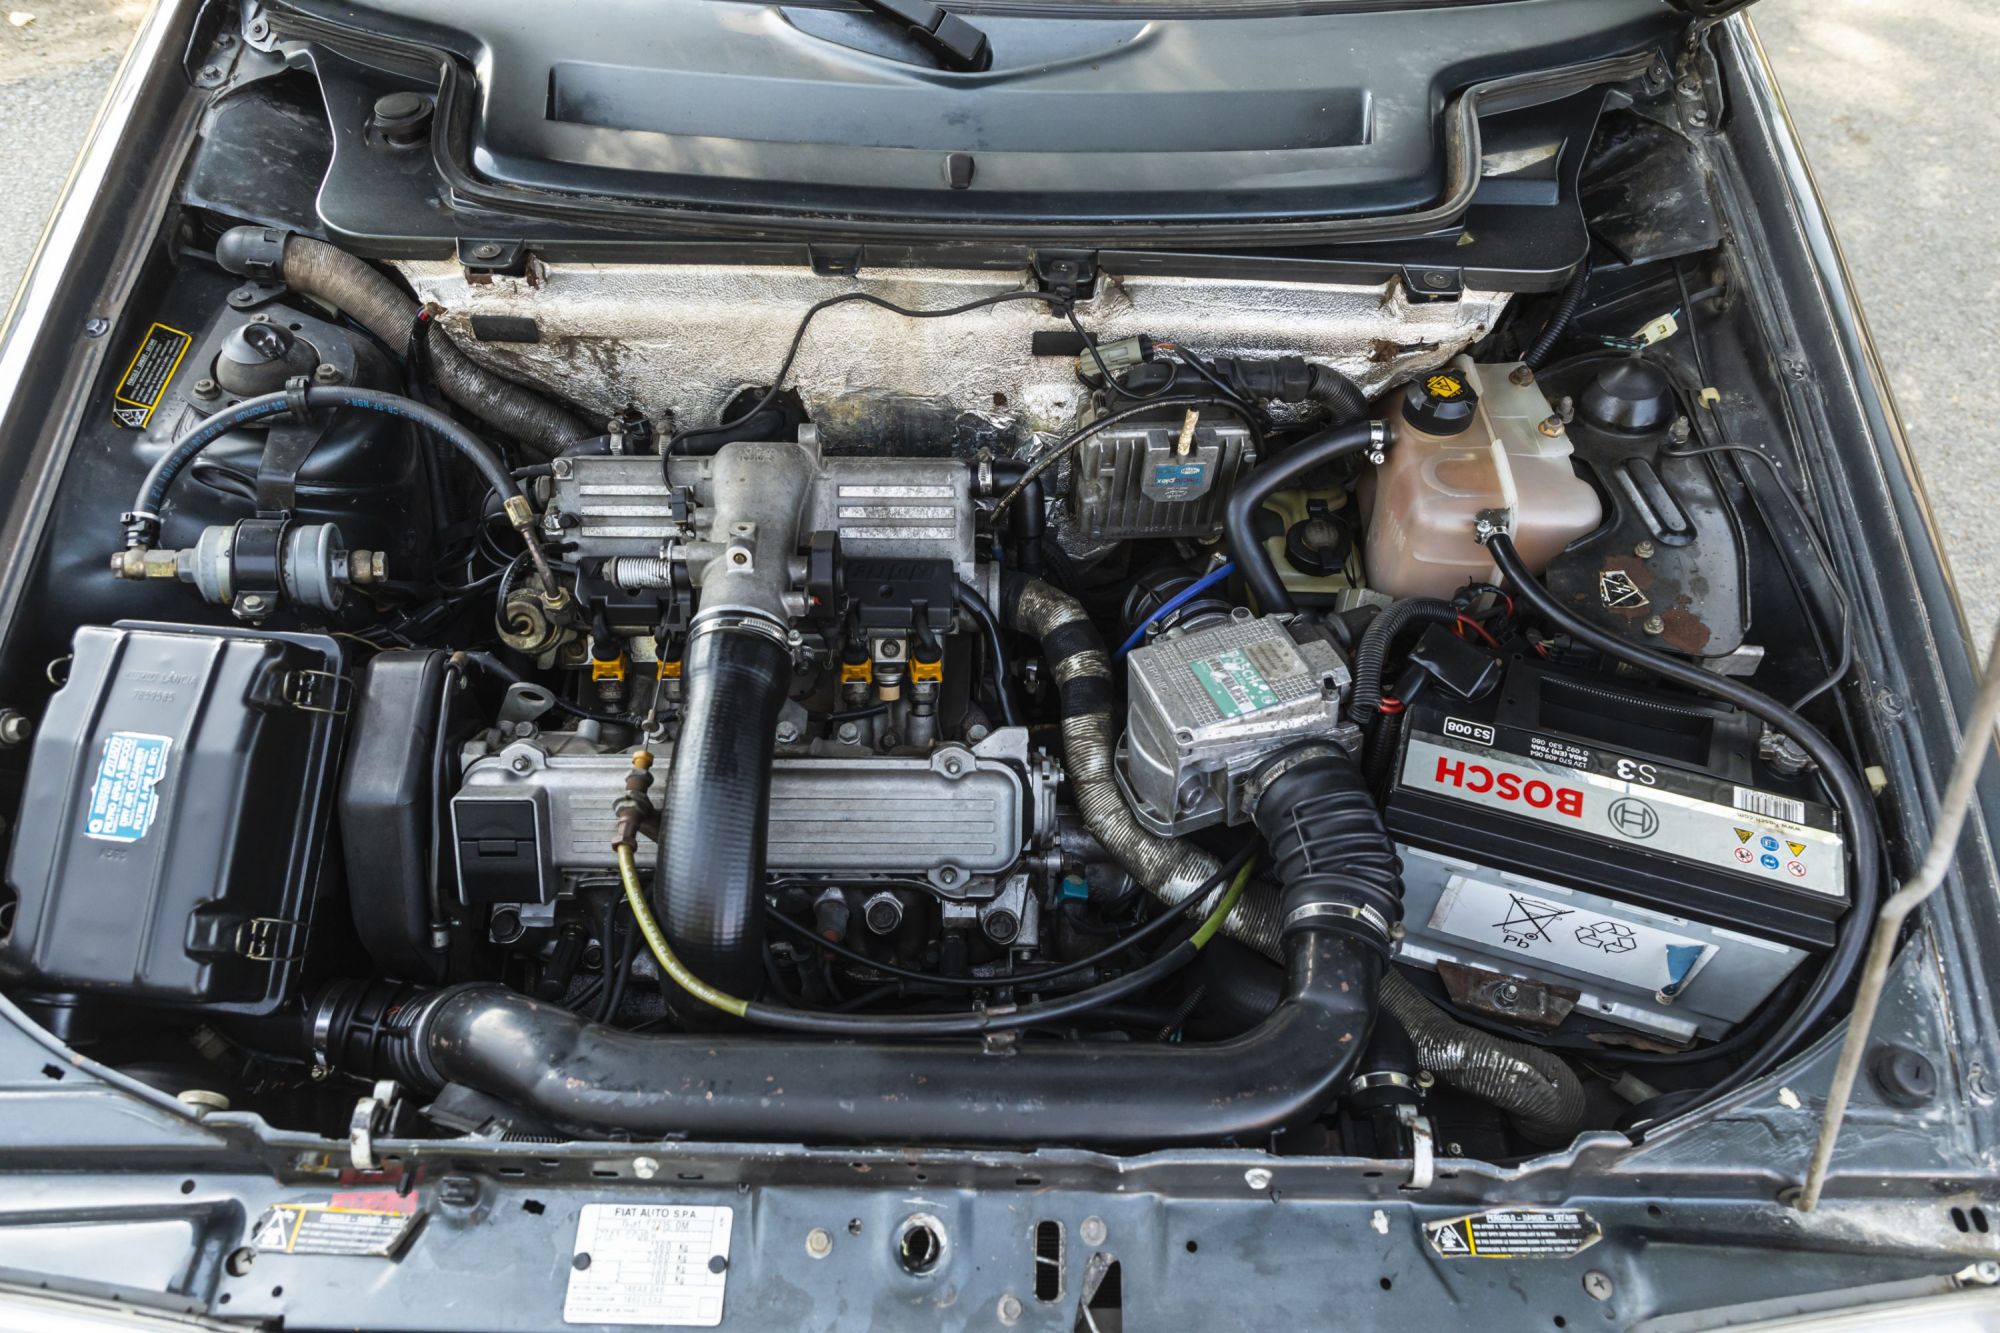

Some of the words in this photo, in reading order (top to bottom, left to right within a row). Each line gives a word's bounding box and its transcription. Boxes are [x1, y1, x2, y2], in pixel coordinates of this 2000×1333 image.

[1446, 720, 1473, 736] 008
[1473, 727, 1492, 741] S3
[1531, 737, 1546, 746] 080
[1530, 743, 1551, 753] 70Ah
[1551, 747, 1568, 758] (EN)
[1566, 745, 1581, 754] 092
[1529, 749, 1544, 759] 064
[1544, 753, 1559, 762] 409
[1568, 752, 1589, 763] 640A
[1559, 756, 1573, 766] 570
[1573, 761, 1587, 769] 12V
[1616, 758, 1657, 786] S3
[1435, 756, 1584, 819] BOSCH
[1503, 934, 1530, 949] Pb
[614, 1207, 638, 1217] FIAT
[640, 1207, 670, 1218] AUTO
